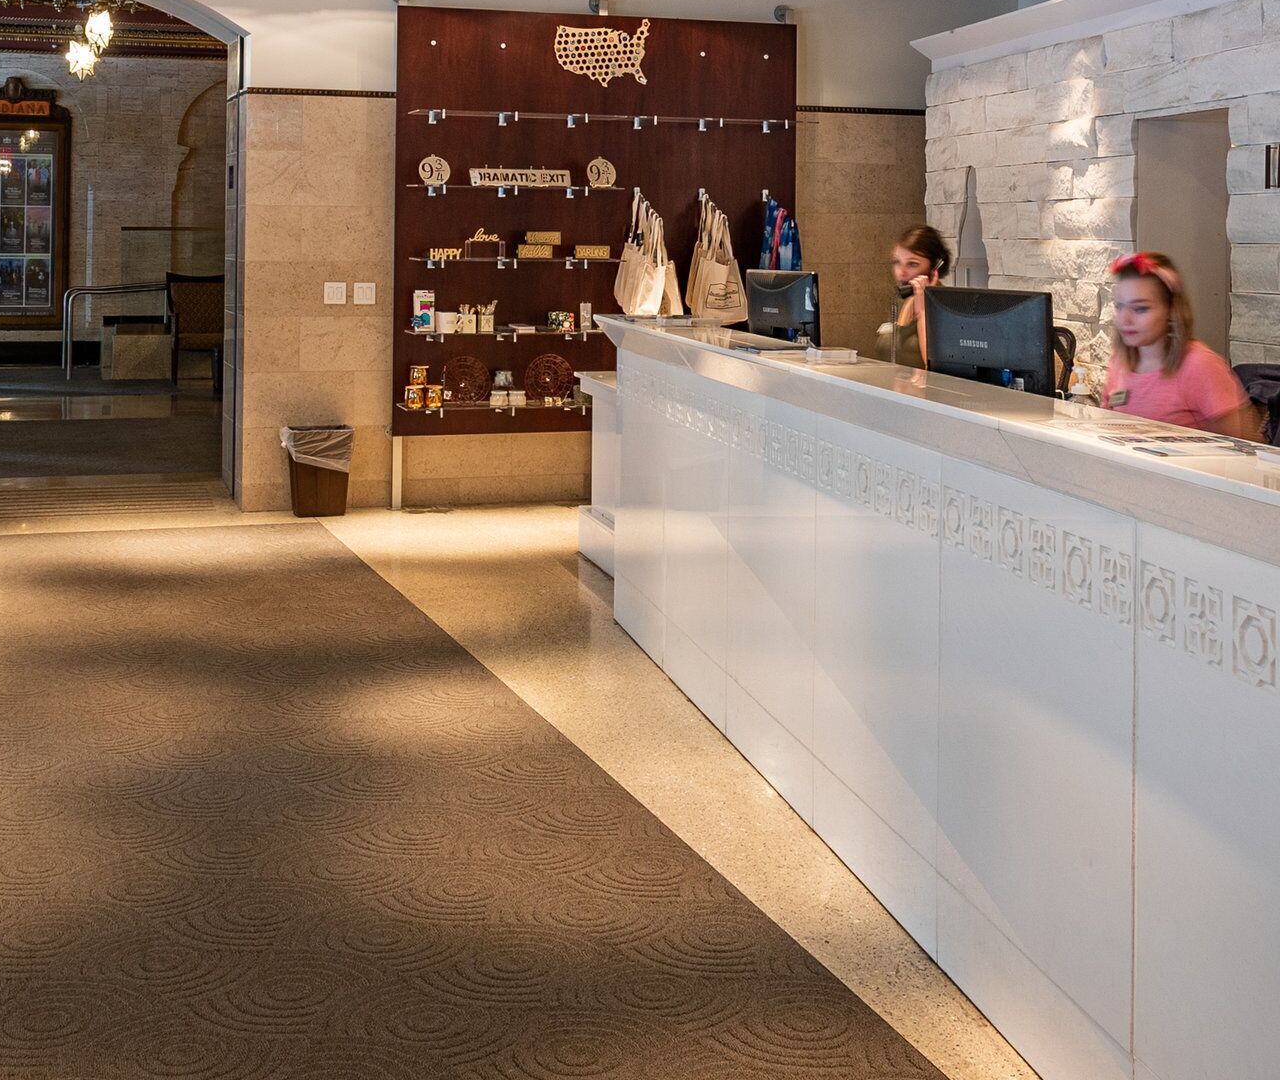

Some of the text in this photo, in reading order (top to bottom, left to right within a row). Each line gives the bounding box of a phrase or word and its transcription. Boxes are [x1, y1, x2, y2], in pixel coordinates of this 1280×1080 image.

[540, 173, 566, 183] EXIT
[469, 228, 500, 242] love
[429, 248, 462, 260] HAPPY
[575, 247, 608, 258] DARLING
[959, 338, 988, 349] SAMSUNG
